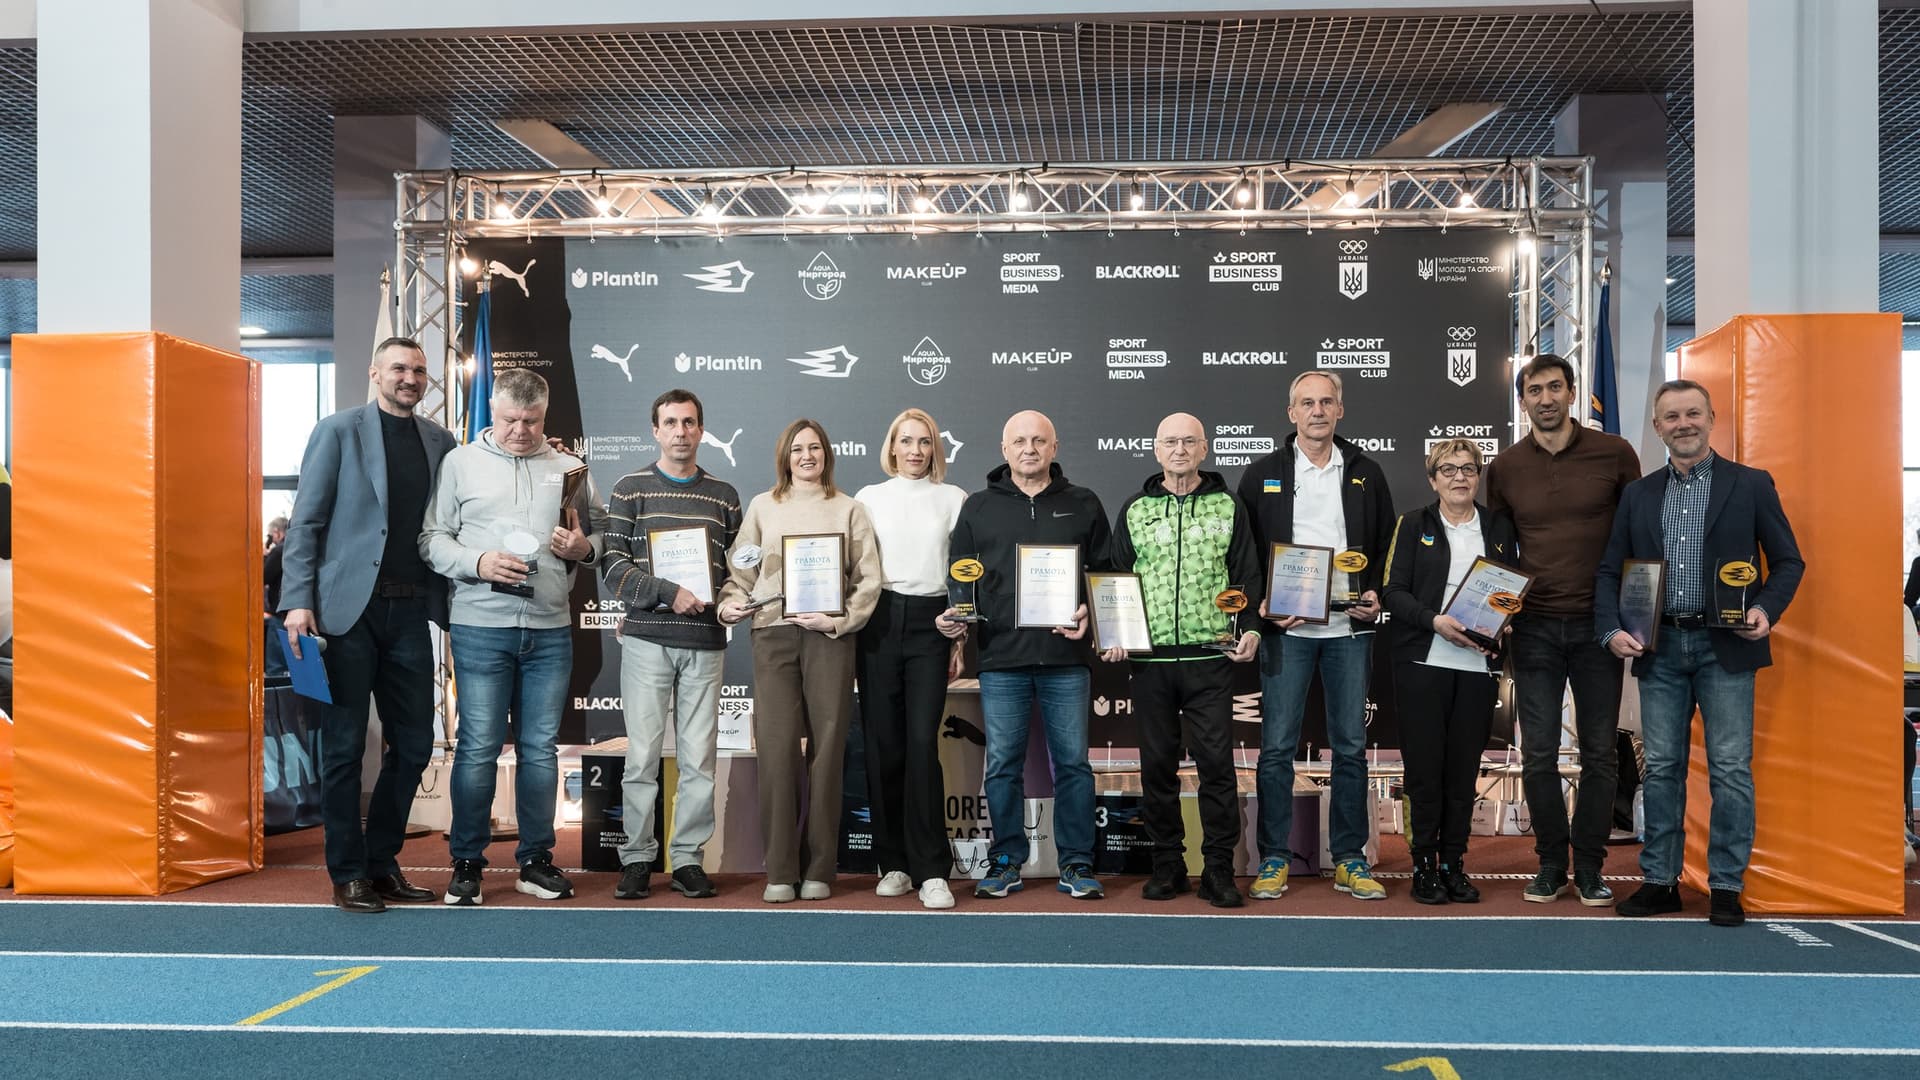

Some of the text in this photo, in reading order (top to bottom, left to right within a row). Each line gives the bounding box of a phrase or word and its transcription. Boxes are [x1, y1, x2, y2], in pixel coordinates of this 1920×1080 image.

[1002, 253, 1041, 263] SPORT
[1230, 252, 1276, 263] SPORT
[798, 270, 847, 280] Миргород
[887, 263, 967, 279] MAKEUP
[1096, 266, 1178, 279] BLACKROLL
[1213, 268, 1278, 279] BUSINESS
[1002, 284, 1039, 294] MEDIA
[1252, 283, 1280, 292] CLUB
[1109, 338, 1147, 348] SPORT
[1338, 338, 1384, 349] SPORT
[903, 355, 951, 365] Миргород
[992, 348, 1072, 364] MAKEUP
[1202, 352, 1286, 365] BLACKROLL
[1321, 354, 1385, 365] BUSINESS
[1109, 370, 1145, 380] MEDIA
[1360, 369, 1387, 378] CLUB
[1216, 425, 1254, 435] SPORT
[1446, 425, 1493, 436] SPORT
[1098, 438, 1154, 450] MAKE
[1216, 457, 1251, 466] MEDIA
[661, 548, 698, 558] ГРАМОТА
[795, 556, 831, 565] ГРАМОТА
[1030, 567, 1066, 576] ГРАМОТА
[1282, 563, 1319, 574] ГРАМОТА
[600, 600, 625, 610] SPO
[585, 616, 621, 625] BUSIN
[721, 686, 748, 696] ORT
[574, 697, 623, 710] BLACK
[719, 701, 749, 711] NESS
[590, 766, 602, 786] 2
[1096, 807, 1108, 827] 3
